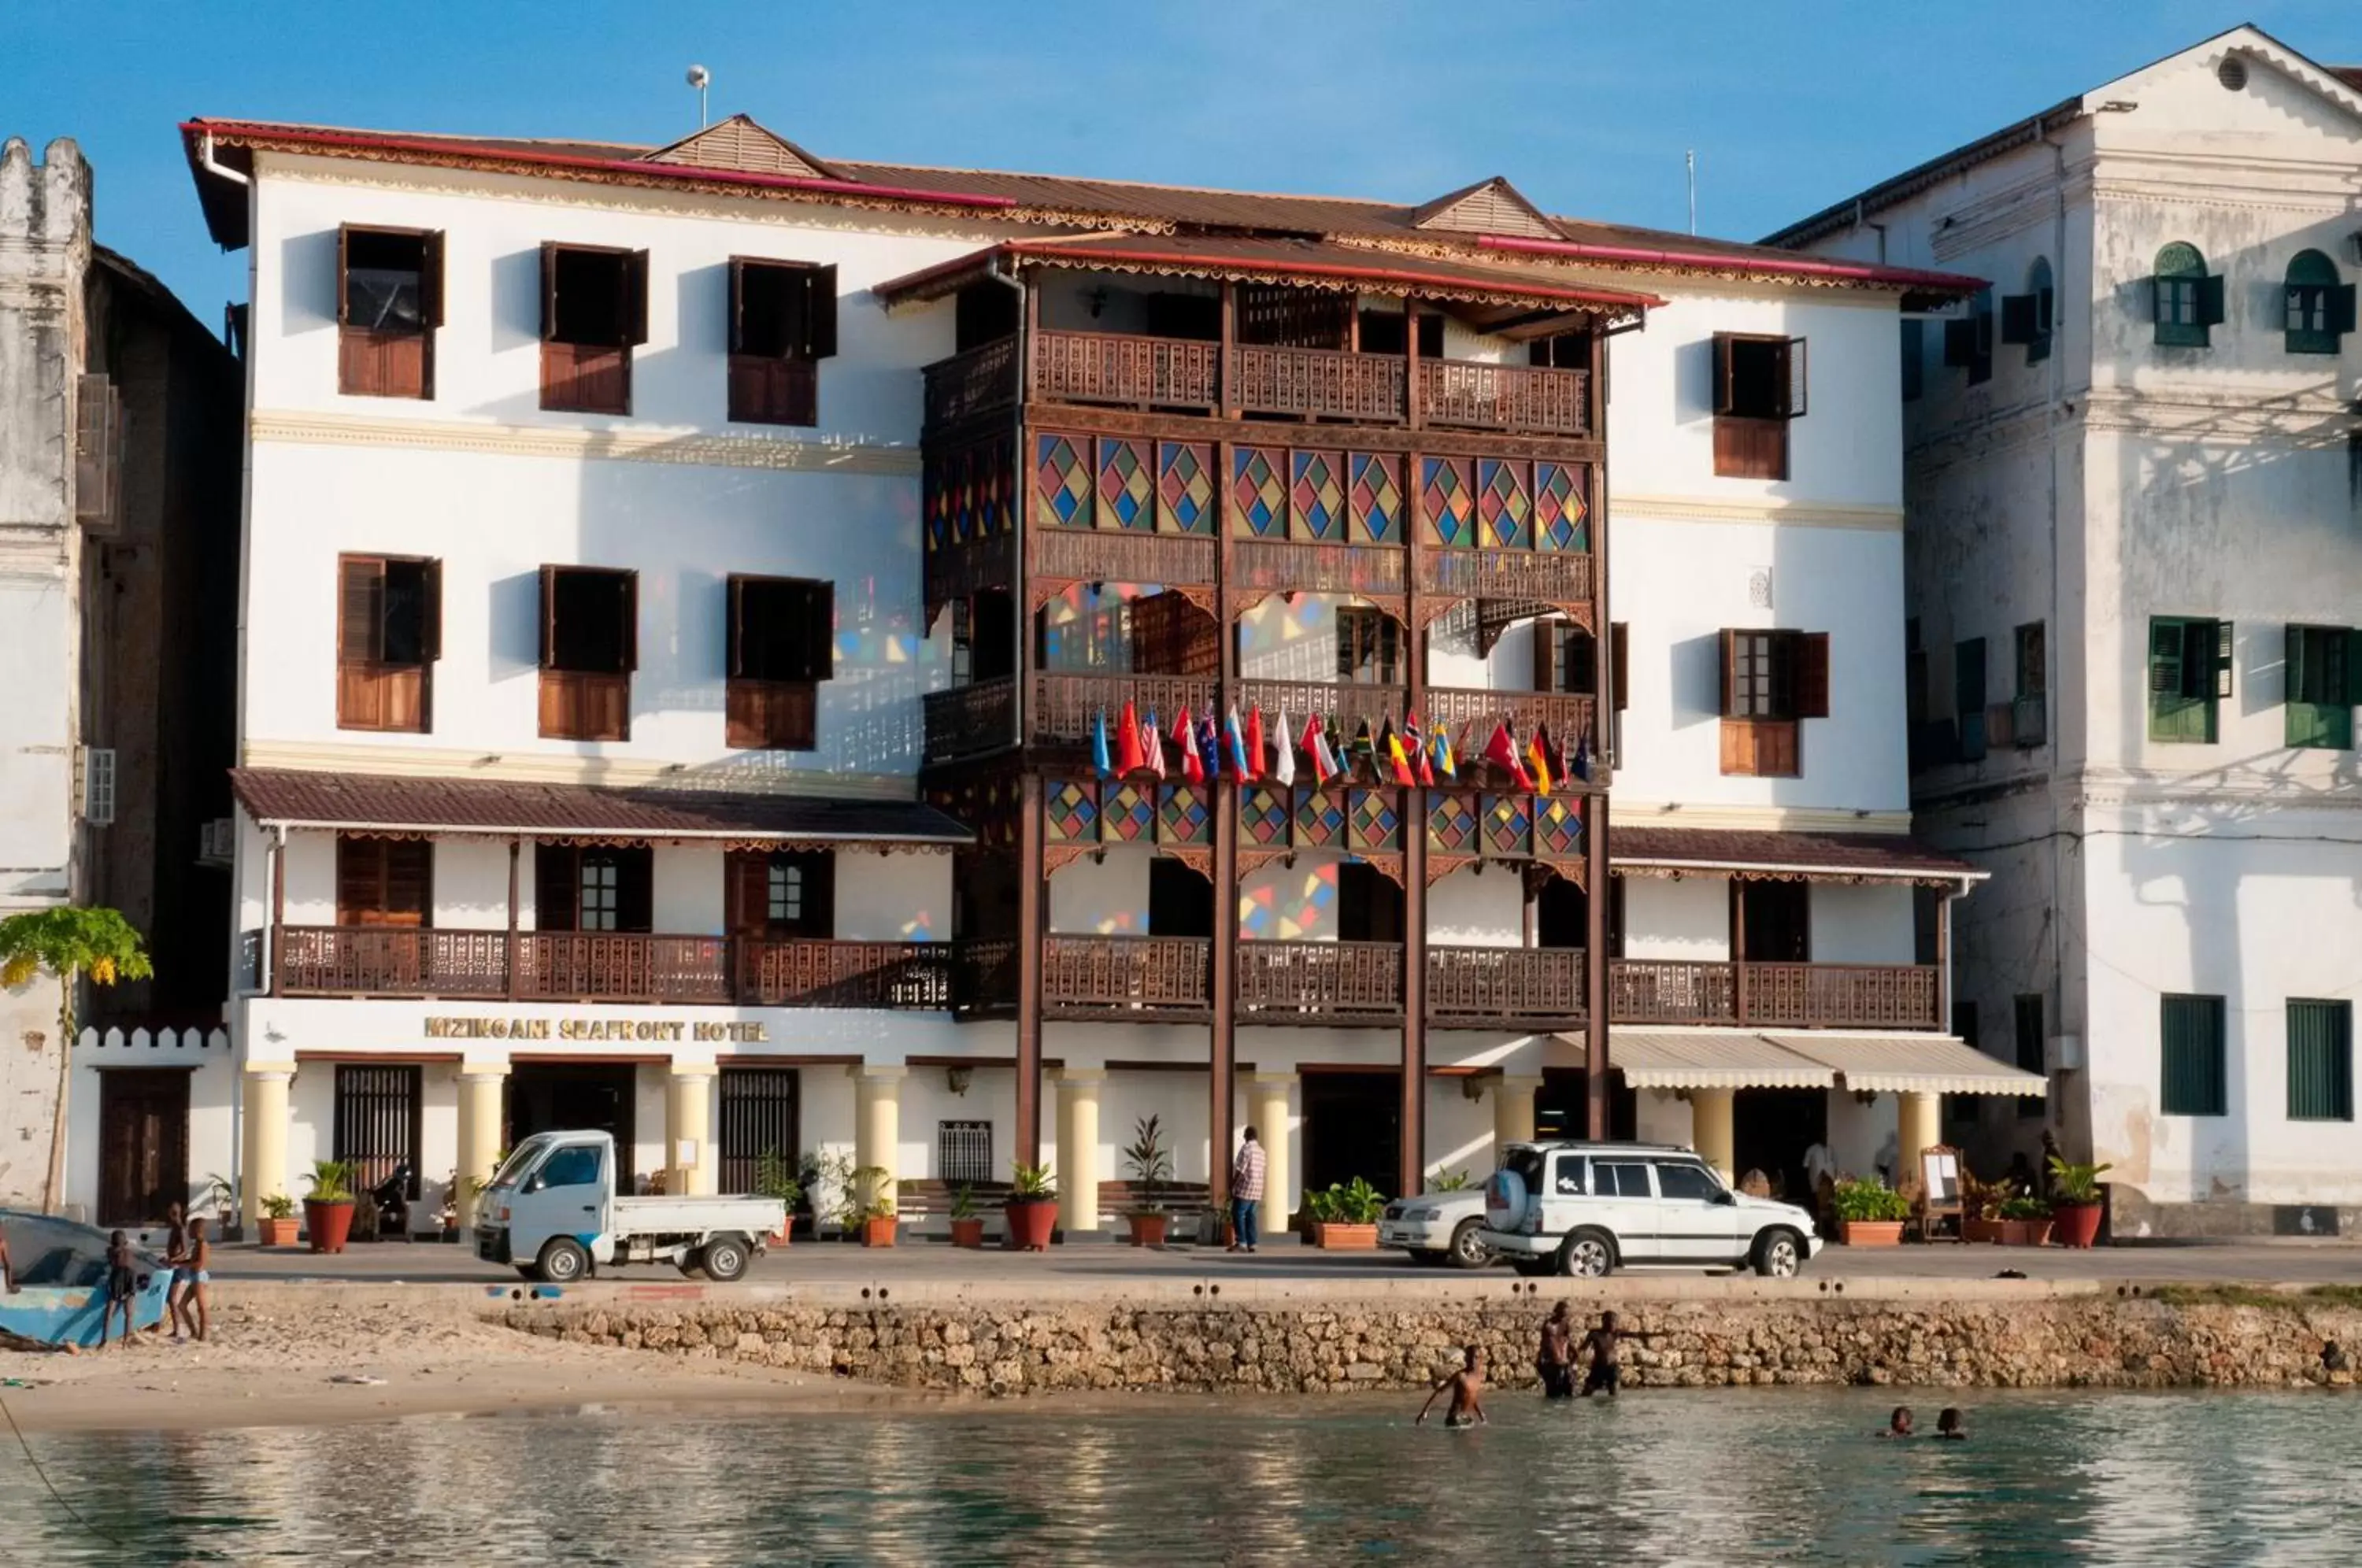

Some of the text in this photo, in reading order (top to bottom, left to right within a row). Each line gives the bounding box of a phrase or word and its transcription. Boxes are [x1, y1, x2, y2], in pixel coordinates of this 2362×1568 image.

[424, 1017, 769, 1043] MIZINGANI SEAFRONT HOTEL
